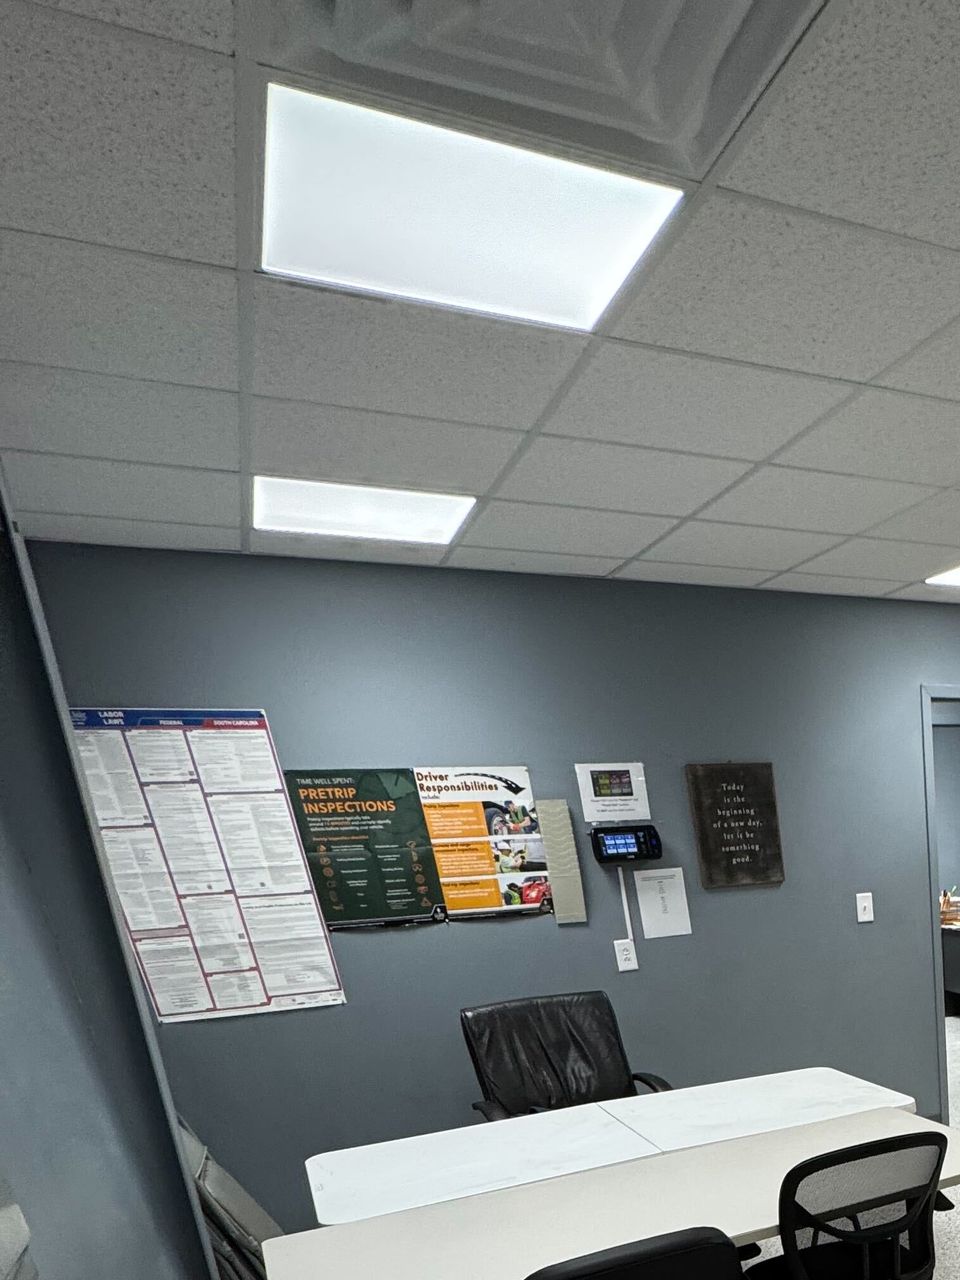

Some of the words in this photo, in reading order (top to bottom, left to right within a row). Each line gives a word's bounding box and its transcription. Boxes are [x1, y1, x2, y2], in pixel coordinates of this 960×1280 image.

[416, 772, 449, 782] Driver
[418, 781, 499, 794] Responsibilities
[721, 782, 744, 792] Today
[298, 787, 357, 800] PRETRIP
[733, 795, 745, 803] the
[303, 800, 397, 814] INSPECTIONS
[717, 808, 755, 817] beginning
[712, 820, 721, 828] of
[745, 830, 754, 838] be
[721, 843, 760, 852] something
